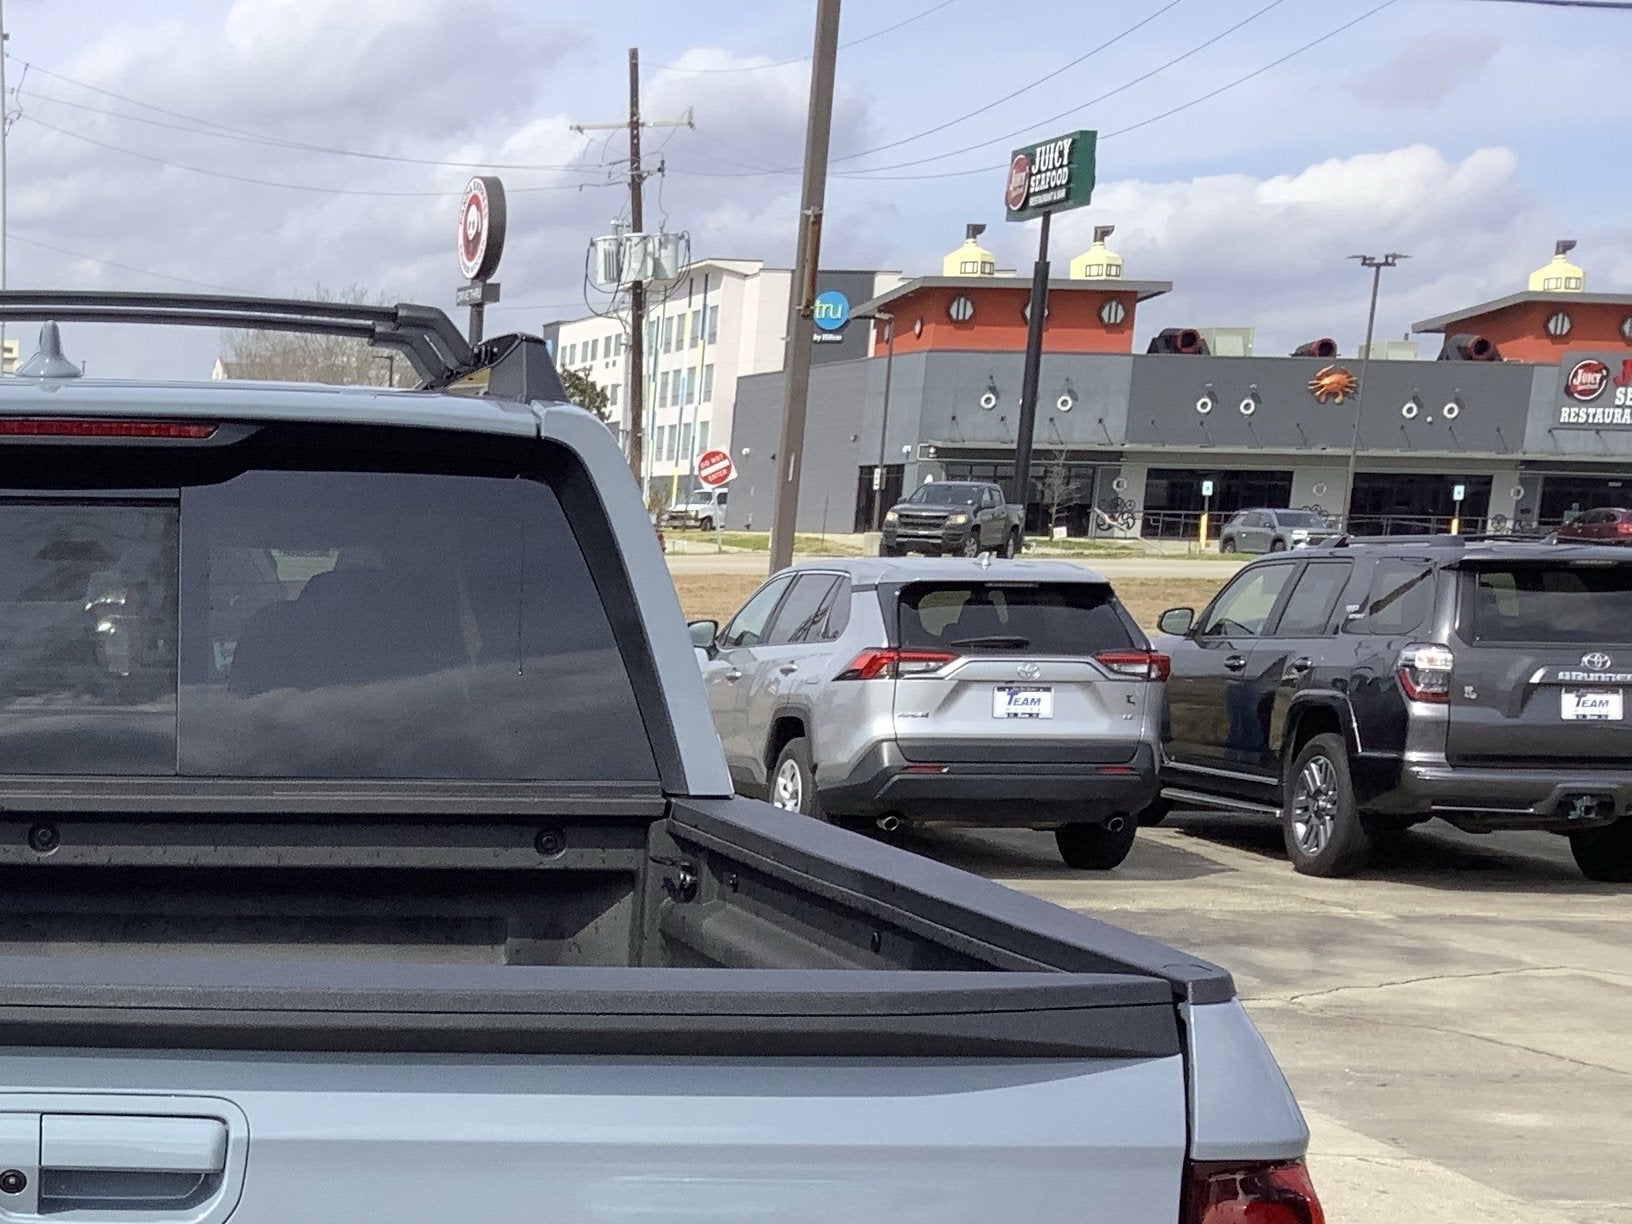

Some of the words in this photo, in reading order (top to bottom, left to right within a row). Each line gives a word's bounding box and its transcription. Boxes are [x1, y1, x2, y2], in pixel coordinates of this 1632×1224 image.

[1031, 138, 1072, 174] JUICY
[1029, 167, 1068, 193] SEAFOOD
[814, 299, 843, 319] tru
[708, 468, 728, 482] ENTER
[1007, 689, 1041, 706] TEAM
[1574, 692, 1610, 708] TEAM
